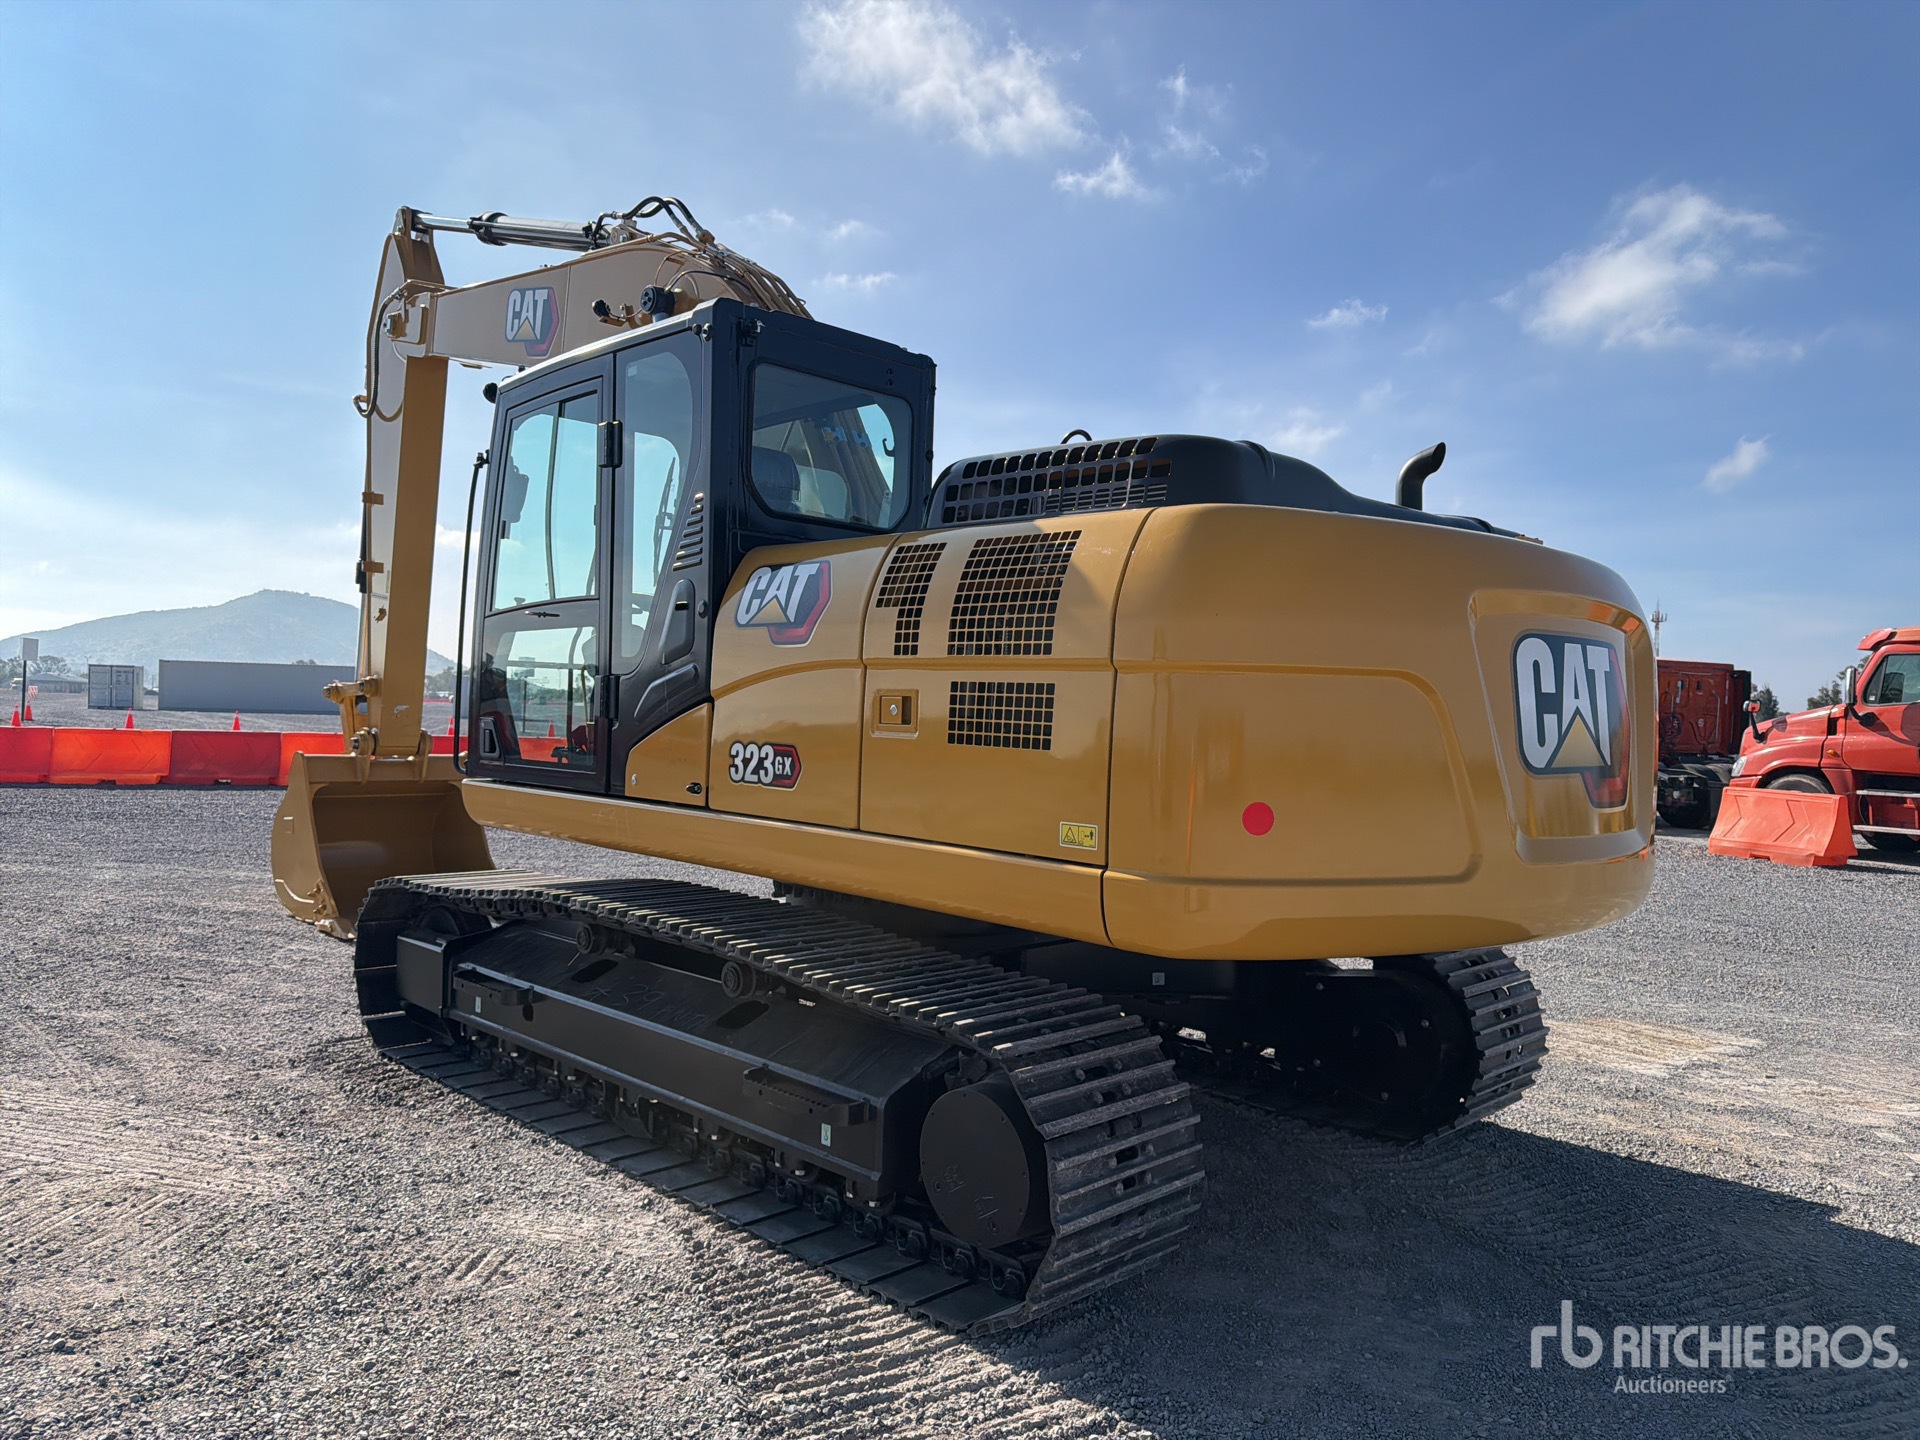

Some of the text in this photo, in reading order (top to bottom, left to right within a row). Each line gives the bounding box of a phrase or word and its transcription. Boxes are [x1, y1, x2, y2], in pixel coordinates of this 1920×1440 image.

[506, 289, 549, 341] CAT
[736, 563, 820, 625] CAT
[1516, 637, 1611, 768] CAT
